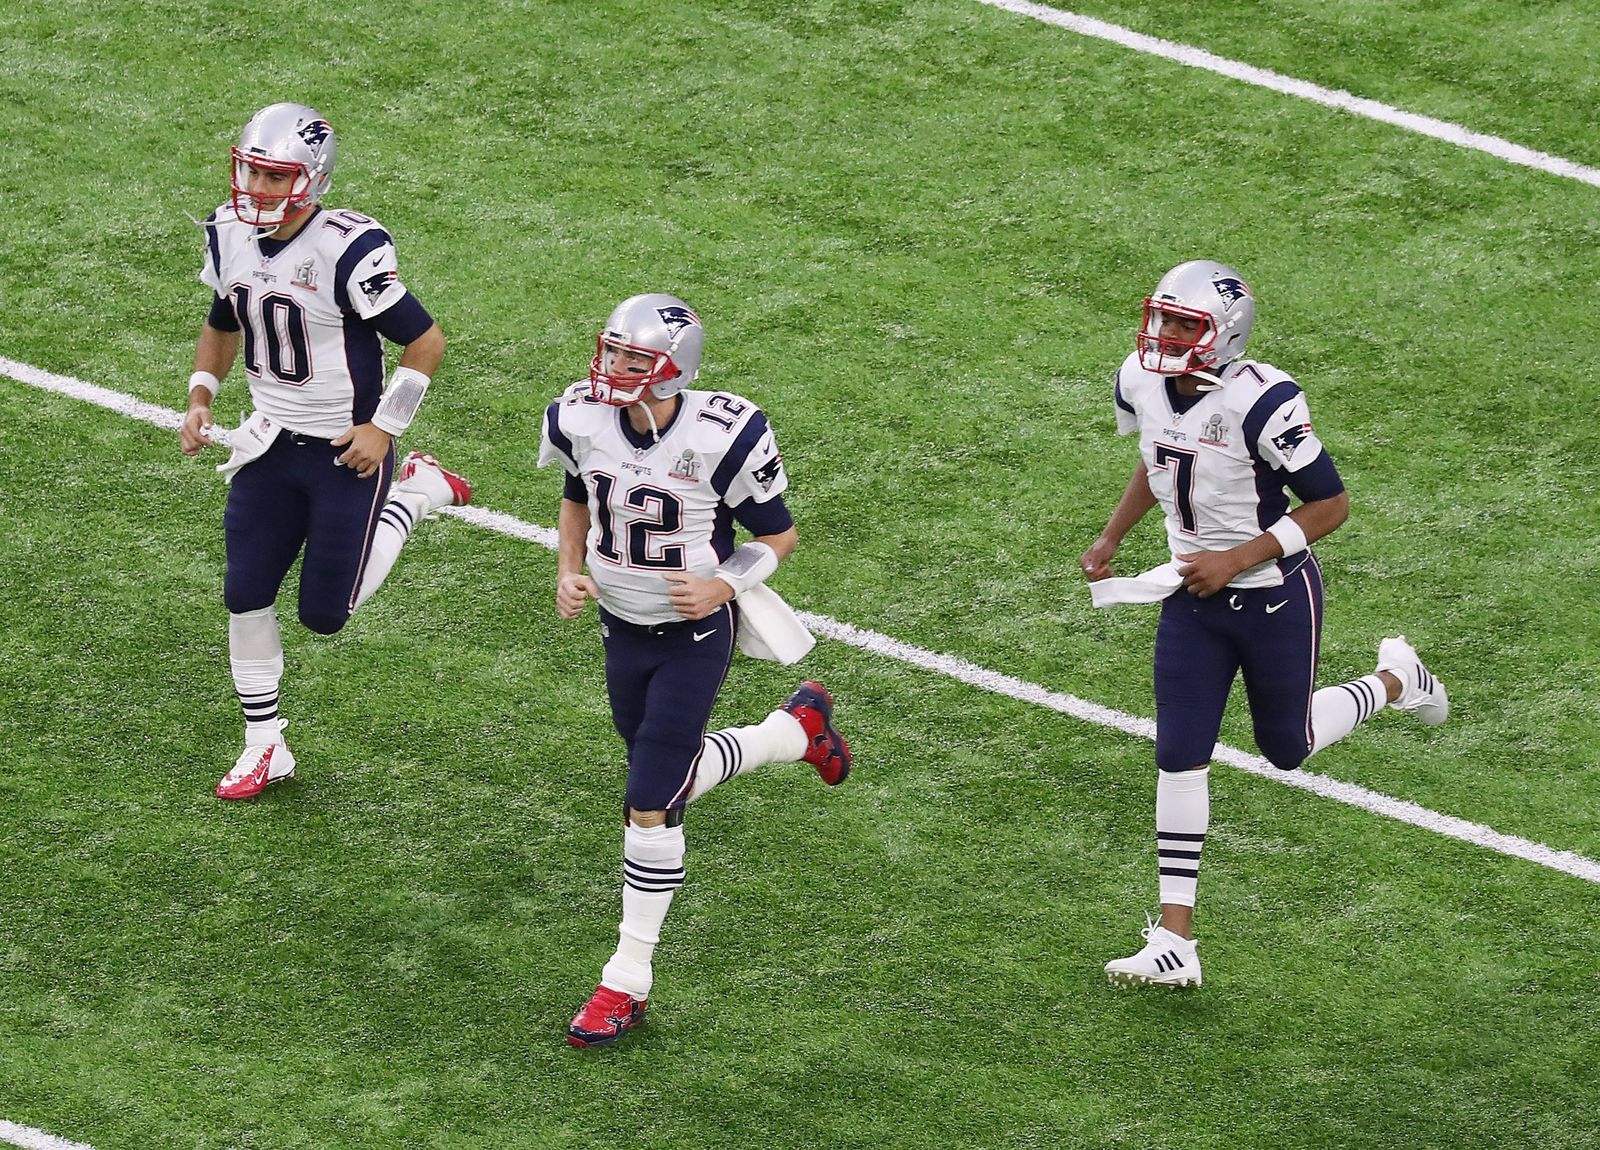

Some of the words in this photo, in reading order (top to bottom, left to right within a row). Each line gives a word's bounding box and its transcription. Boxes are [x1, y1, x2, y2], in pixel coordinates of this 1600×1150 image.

[228, 281, 313, 387] 10
[1231, 362, 1269, 387] 7
[696, 392, 750, 434] 12
[588, 470, 687, 572] 12
[1152, 440, 1199, 537] 7
